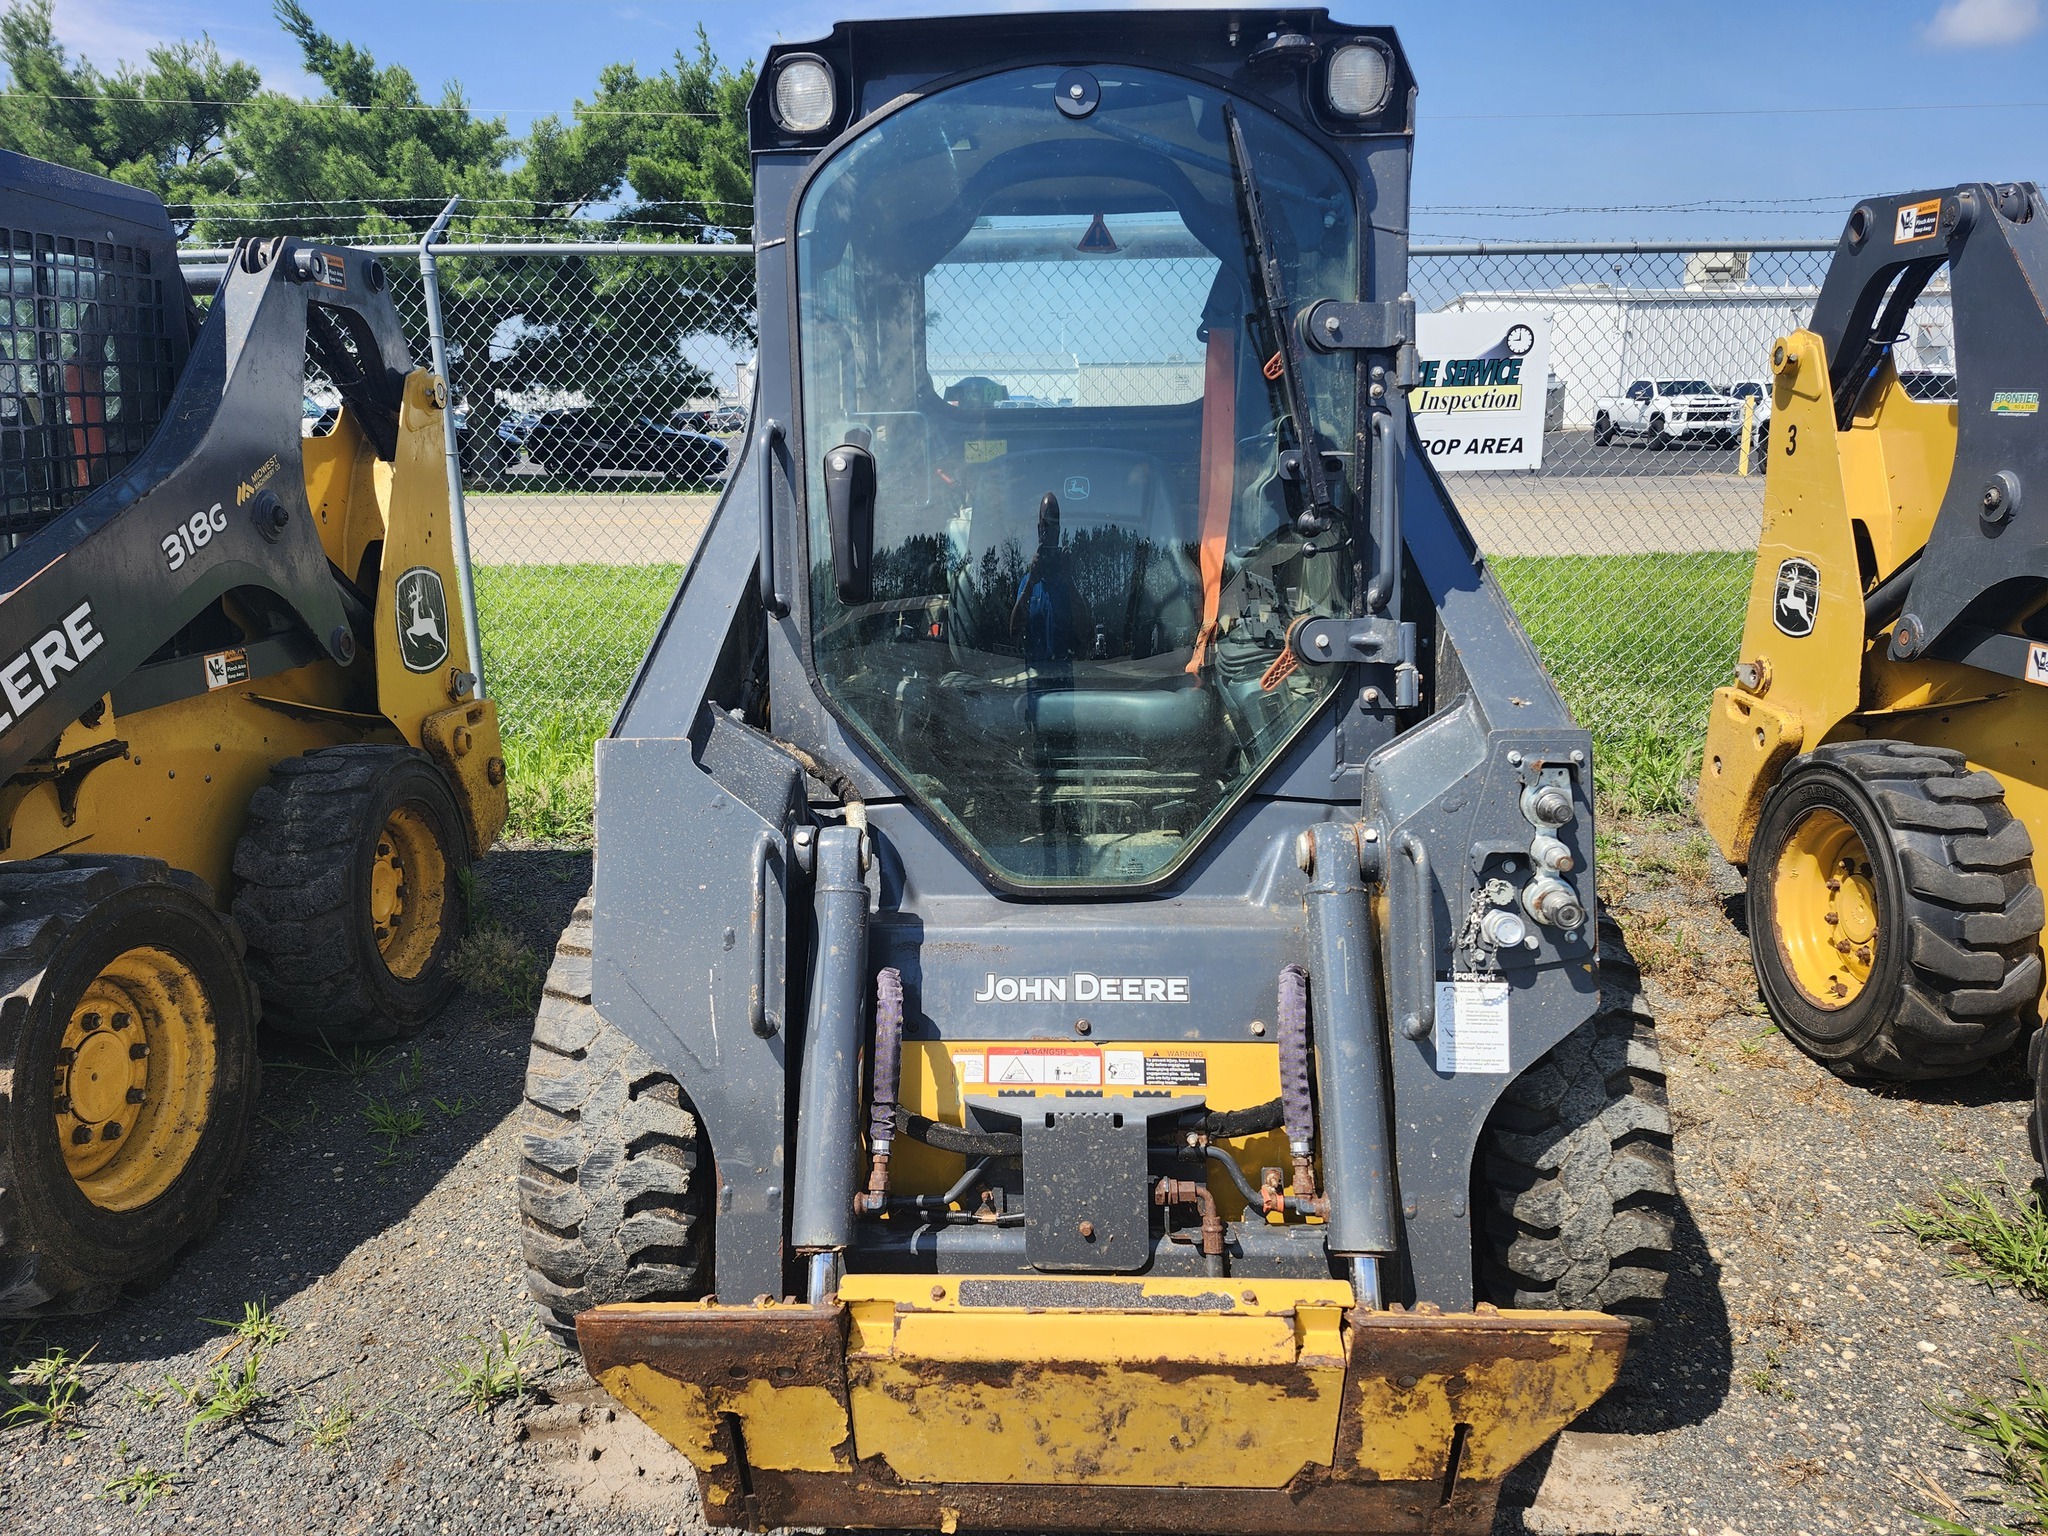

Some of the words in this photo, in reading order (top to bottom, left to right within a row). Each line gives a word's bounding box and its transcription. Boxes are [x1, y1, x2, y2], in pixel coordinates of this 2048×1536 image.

[1442, 358, 1523, 387] SERVICE
[1419, 389, 1518, 415] Inspection
[1995, 393, 2038, 403] FRONTIER
[1464, 438, 1523, 455] AREA
[1786, 424, 1798, 456] 3
[251, 454, 278, 484] MIDWEST
[161, 502, 228, 571] 318G
[0, 601, 104, 733] ERE
[976, 973, 1067, 1001] JOHN
[1074, 973, 1189, 1002] DEERE
